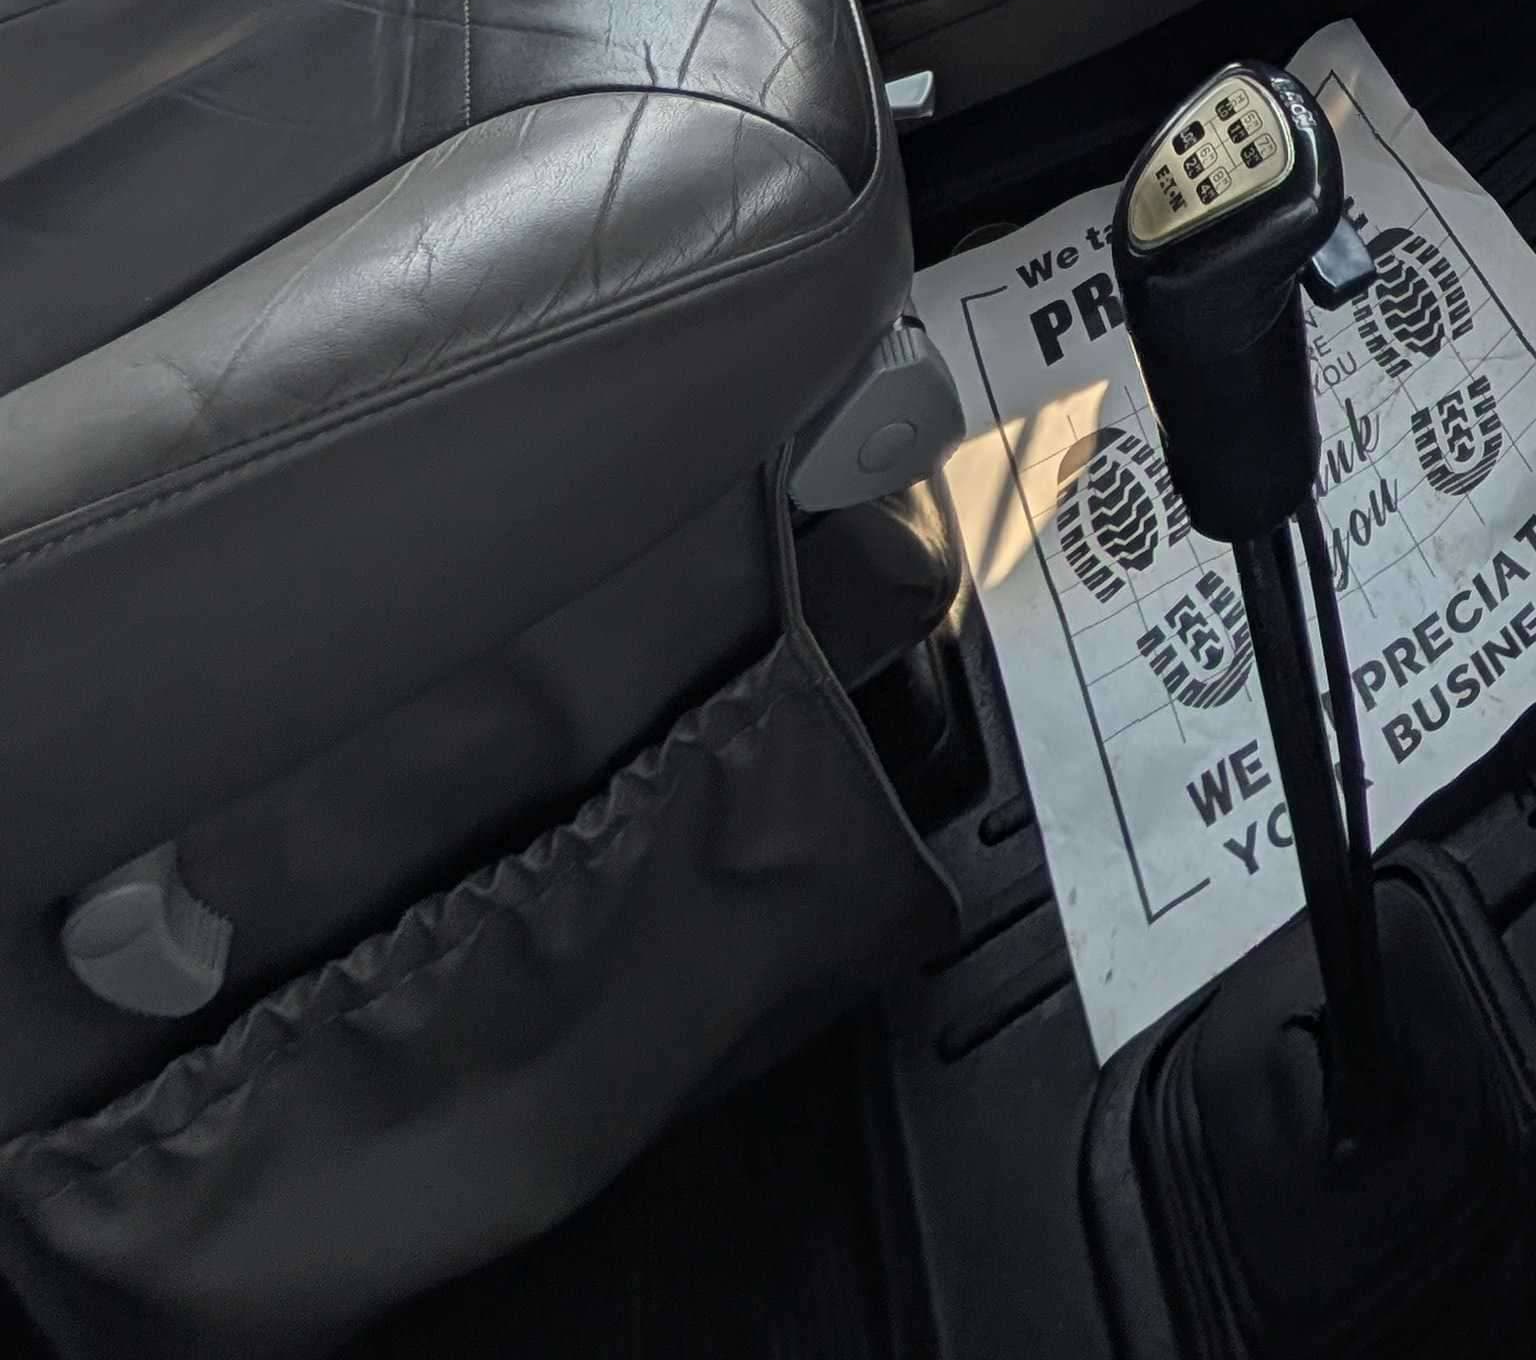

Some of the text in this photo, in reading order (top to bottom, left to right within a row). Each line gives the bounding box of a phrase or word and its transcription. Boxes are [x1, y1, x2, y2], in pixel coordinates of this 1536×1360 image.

[1016, 244, 1080, 289] We
[1030, 273, 1125, 368] PR
[1186, 738, 1272, 828] WE
